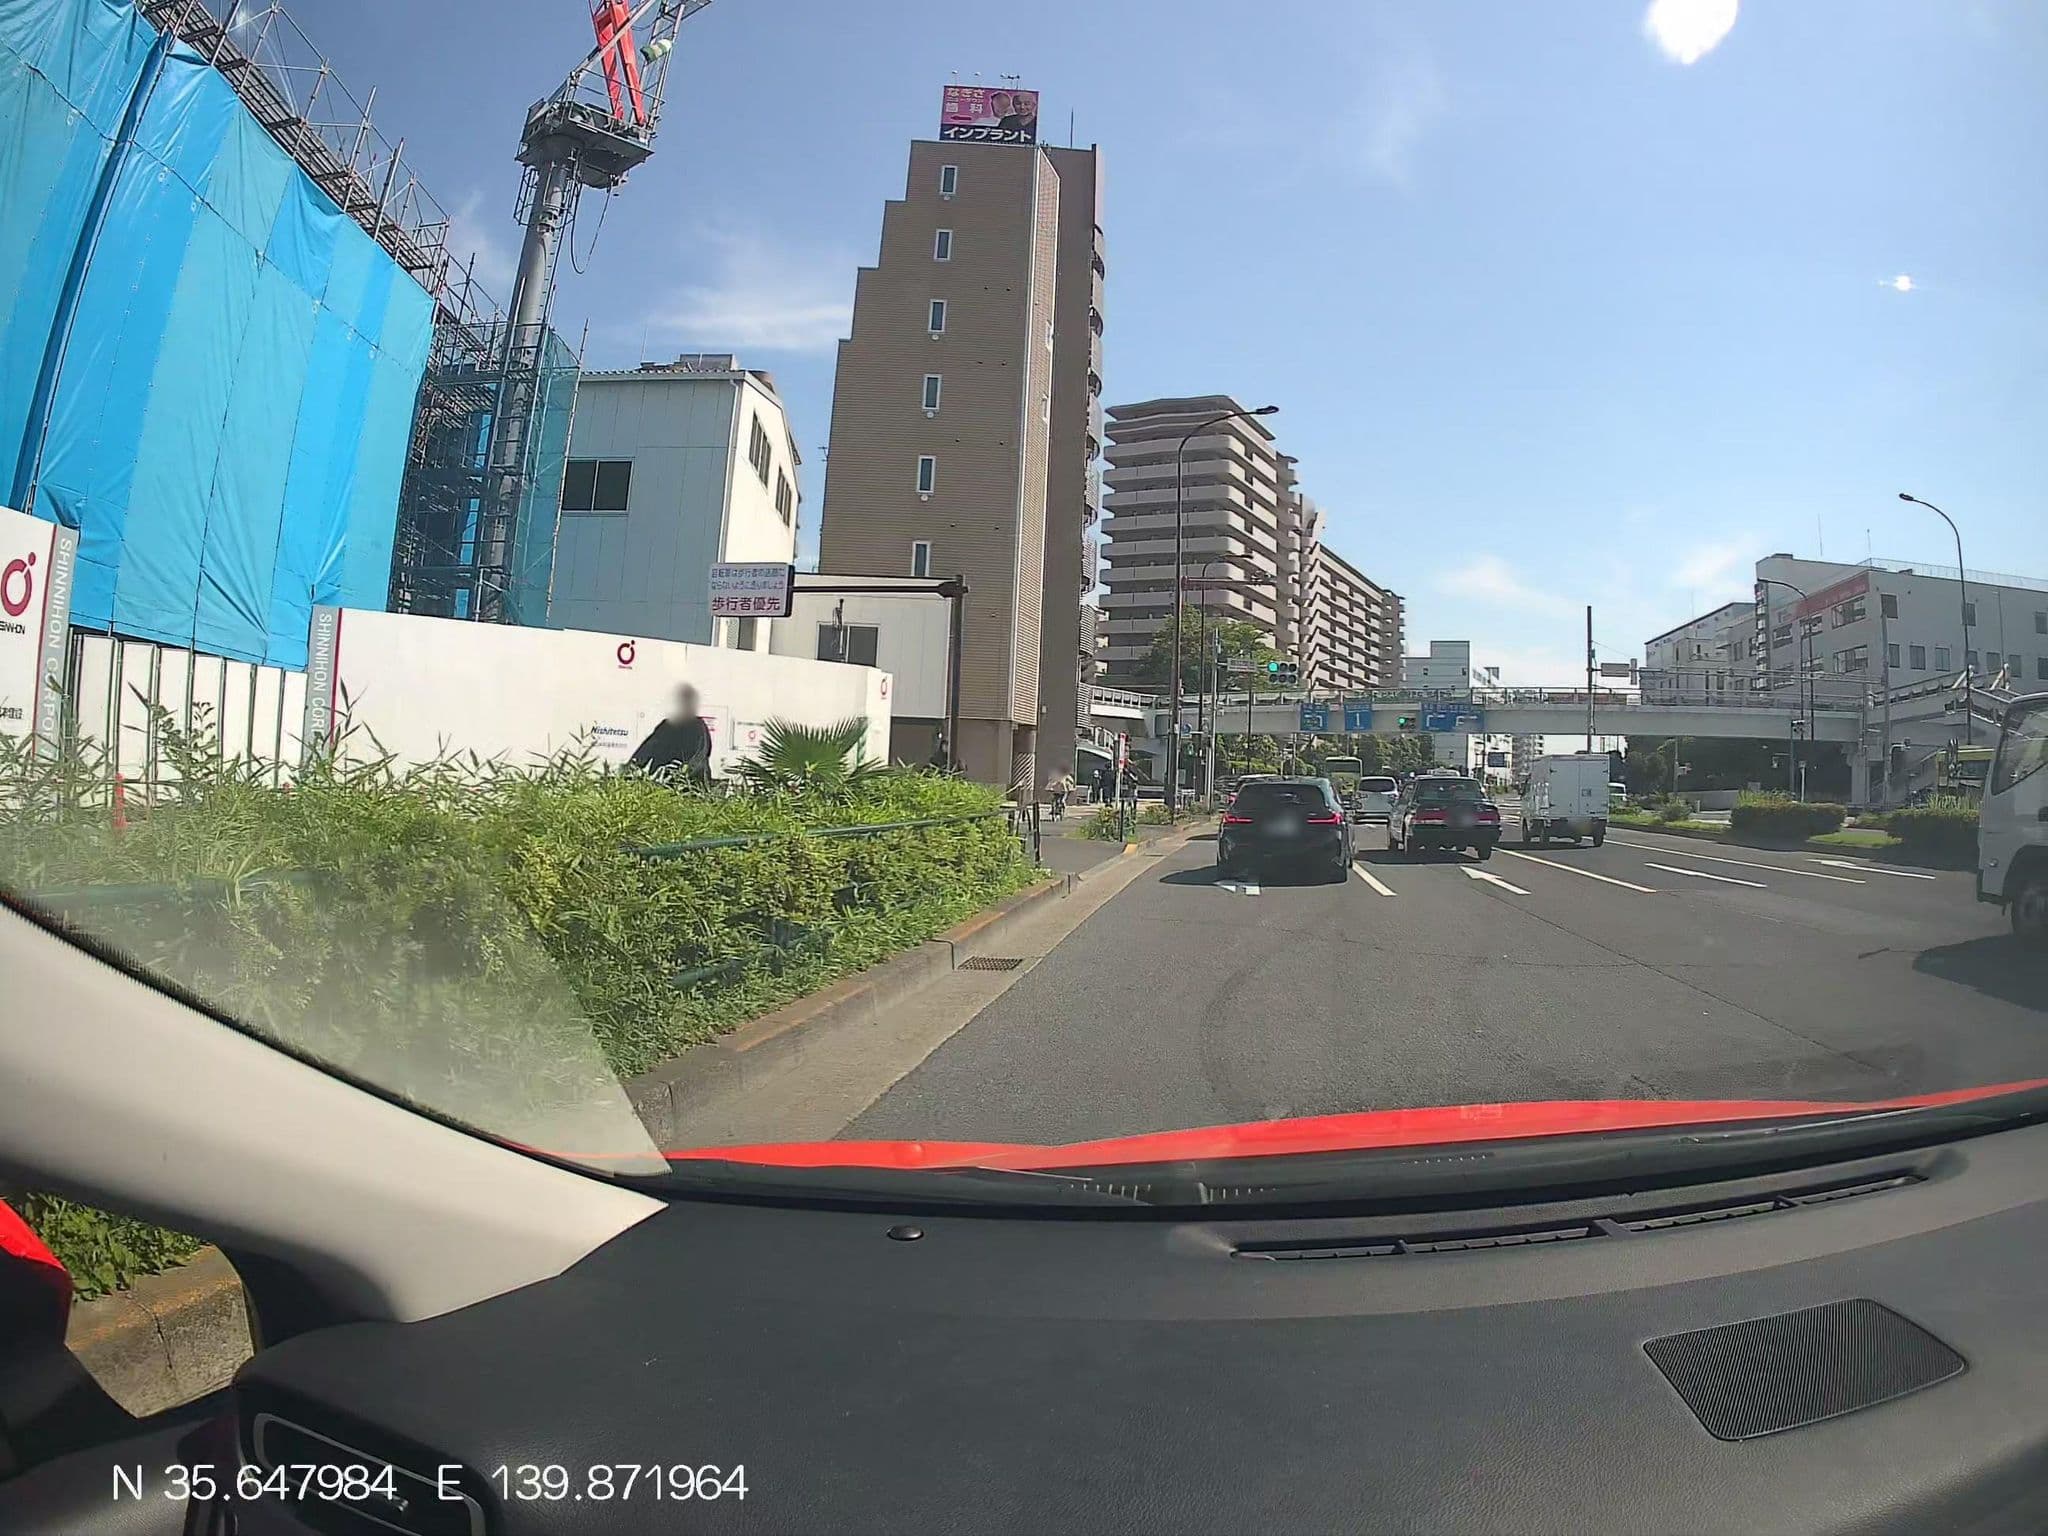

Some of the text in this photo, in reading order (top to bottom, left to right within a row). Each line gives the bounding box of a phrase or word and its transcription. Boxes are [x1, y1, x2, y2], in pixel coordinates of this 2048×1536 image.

[943, 126, 1032, 143] インプラント
[49, 537, 72, 648] SHINNIHON
[712, 597, 780, 611] 歩行者優先
[313, 613, 332, 691] SHINNIHON
